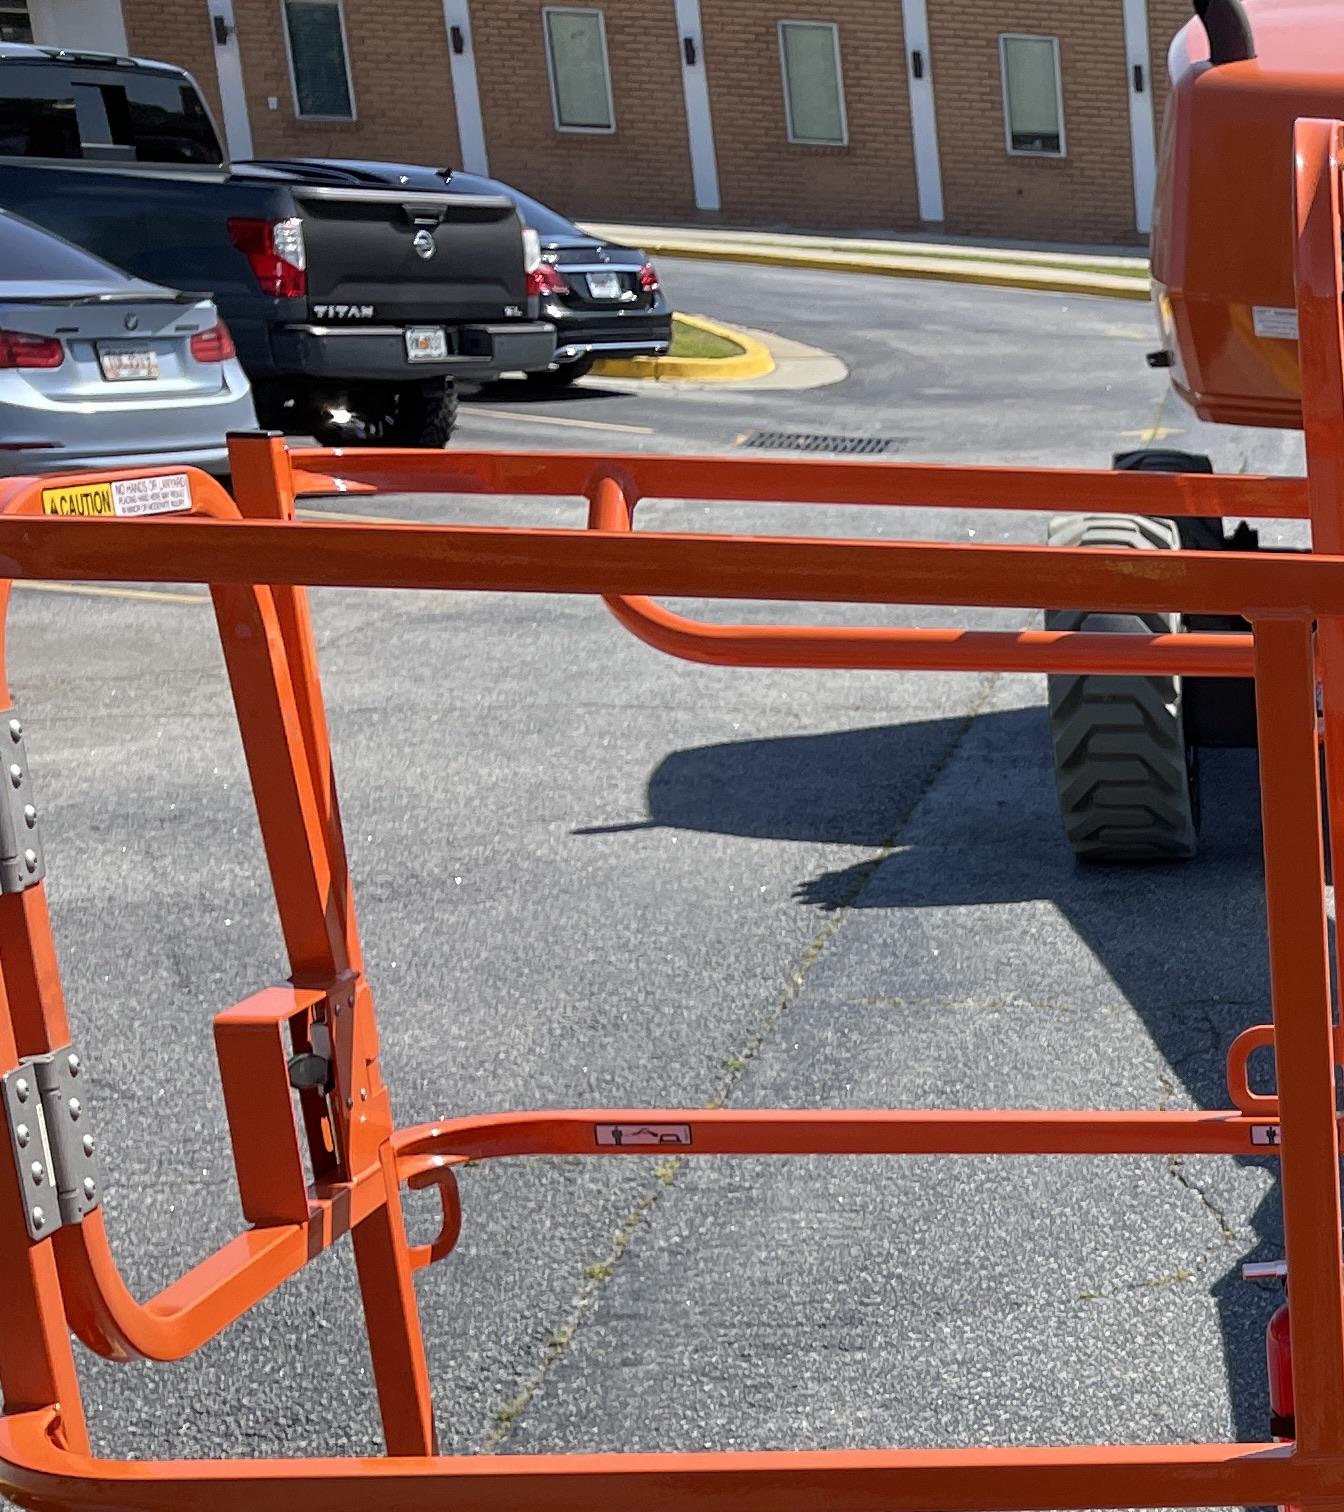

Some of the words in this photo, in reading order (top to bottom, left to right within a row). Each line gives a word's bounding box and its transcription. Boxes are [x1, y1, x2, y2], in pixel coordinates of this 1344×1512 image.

[314, 305, 374, 319] TITAN
[115, 483, 125, 495] NO
[60, 490, 111, 515] CAUTION
